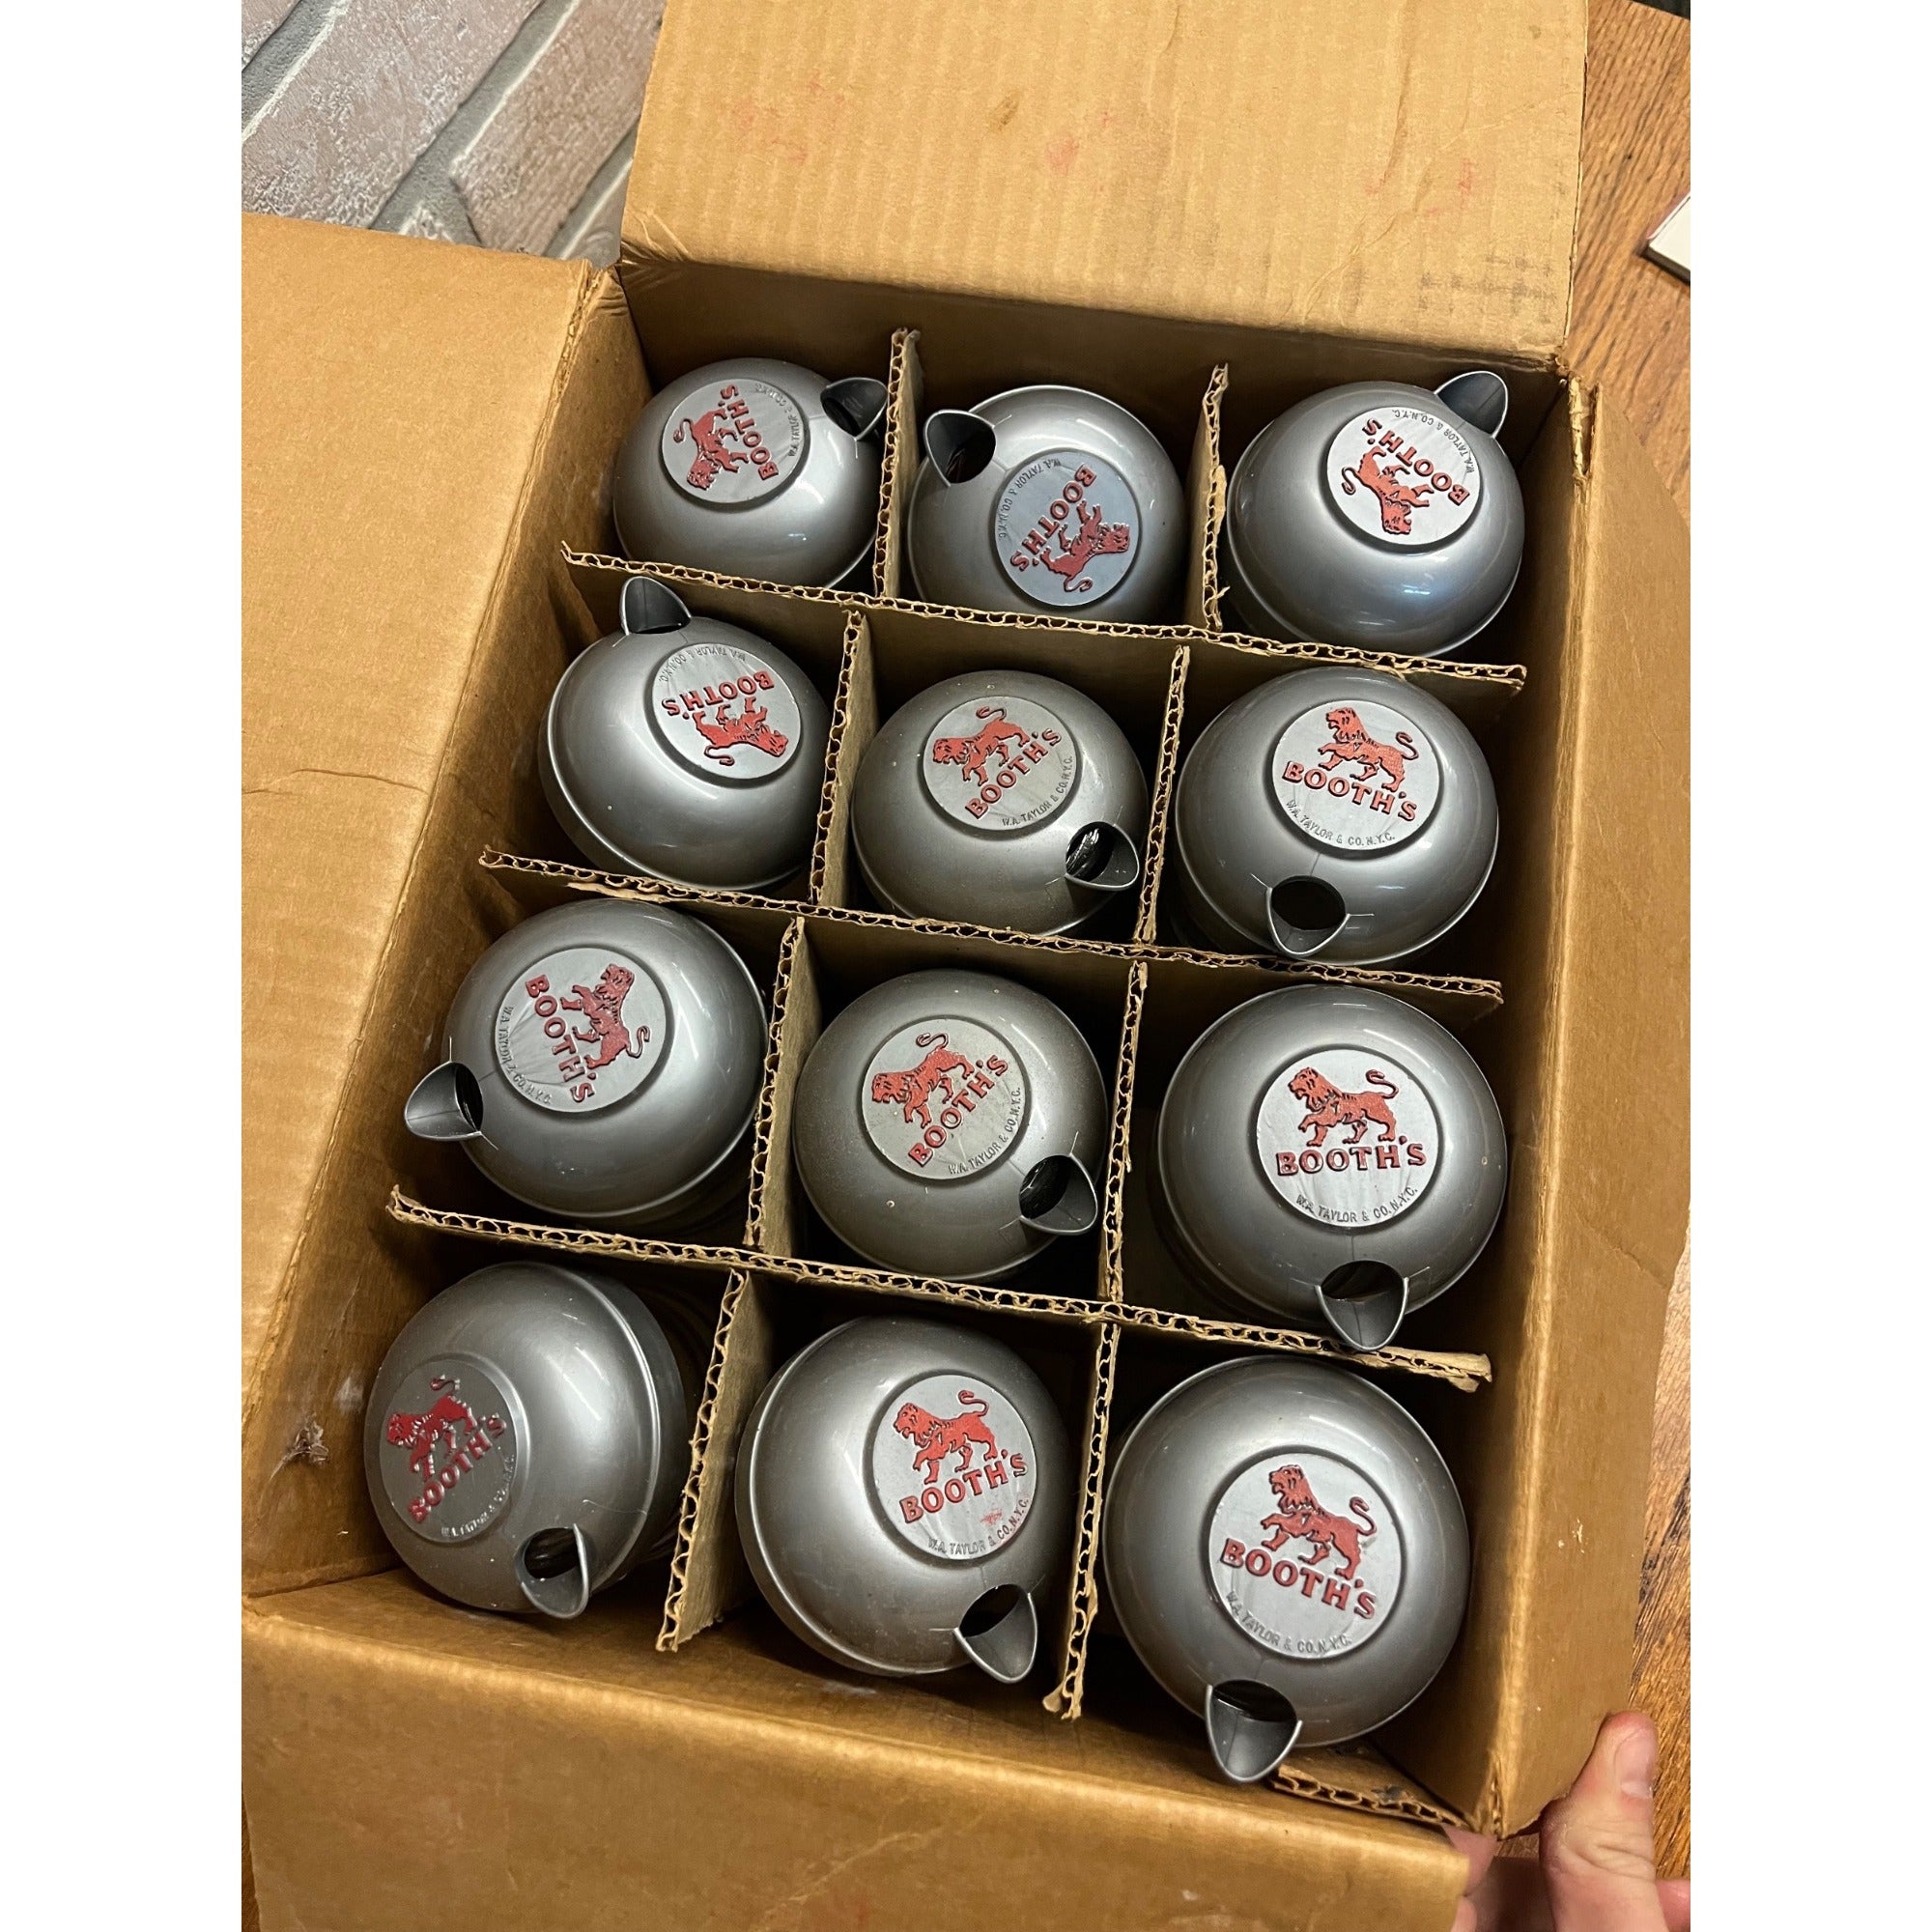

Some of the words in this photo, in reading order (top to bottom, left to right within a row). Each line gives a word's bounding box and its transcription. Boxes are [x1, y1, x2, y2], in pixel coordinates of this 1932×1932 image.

[718, 384, 779, 480] BOOTH'S
[1443, 428, 1467, 457] TAYLOR
[1016, 464, 1044, 489] TAYLOR
[1362, 418, 1469, 506] BOOTH'S
[1010, 464, 1096, 571] BOOTH'S
[696, 647, 727, 656] TAYLOR
[662, 670, 774, 720] BOOTH'S
[965, 728, 1062, 819] BOOTH'S
[1282, 760, 1417, 821] BOOTH'S
[1021, 801, 1053, 821] TAYLOR
[1299, 814, 1334, 840] TAYLOR
[497, 1026, 513, 1064] TAYLOR
[526, 974, 597, 1102] BOOTH'S
[908, 1054, 1009, 1167] BOOTH'S
[968, 1143, 1002, 1170] TAYLOR
[999, 1134, 1009, 1143] &
[1276, 1136, 1428, 1177] BOOTH'S
[1318, 1205, 1357, 1223] TAYLOR
[1362, 1211, 1370, 1221] &
[408, 1412, 507, 1524] BOOTH'S
[899, 1449, 1027, 1523] BOOTH'S
[949, 1541, 987, 1555] TAYLOR
[1220, 1538, 1376, 1620] BOOTH'S
[1241, 1609, 1281, 1646] TAYLOR
